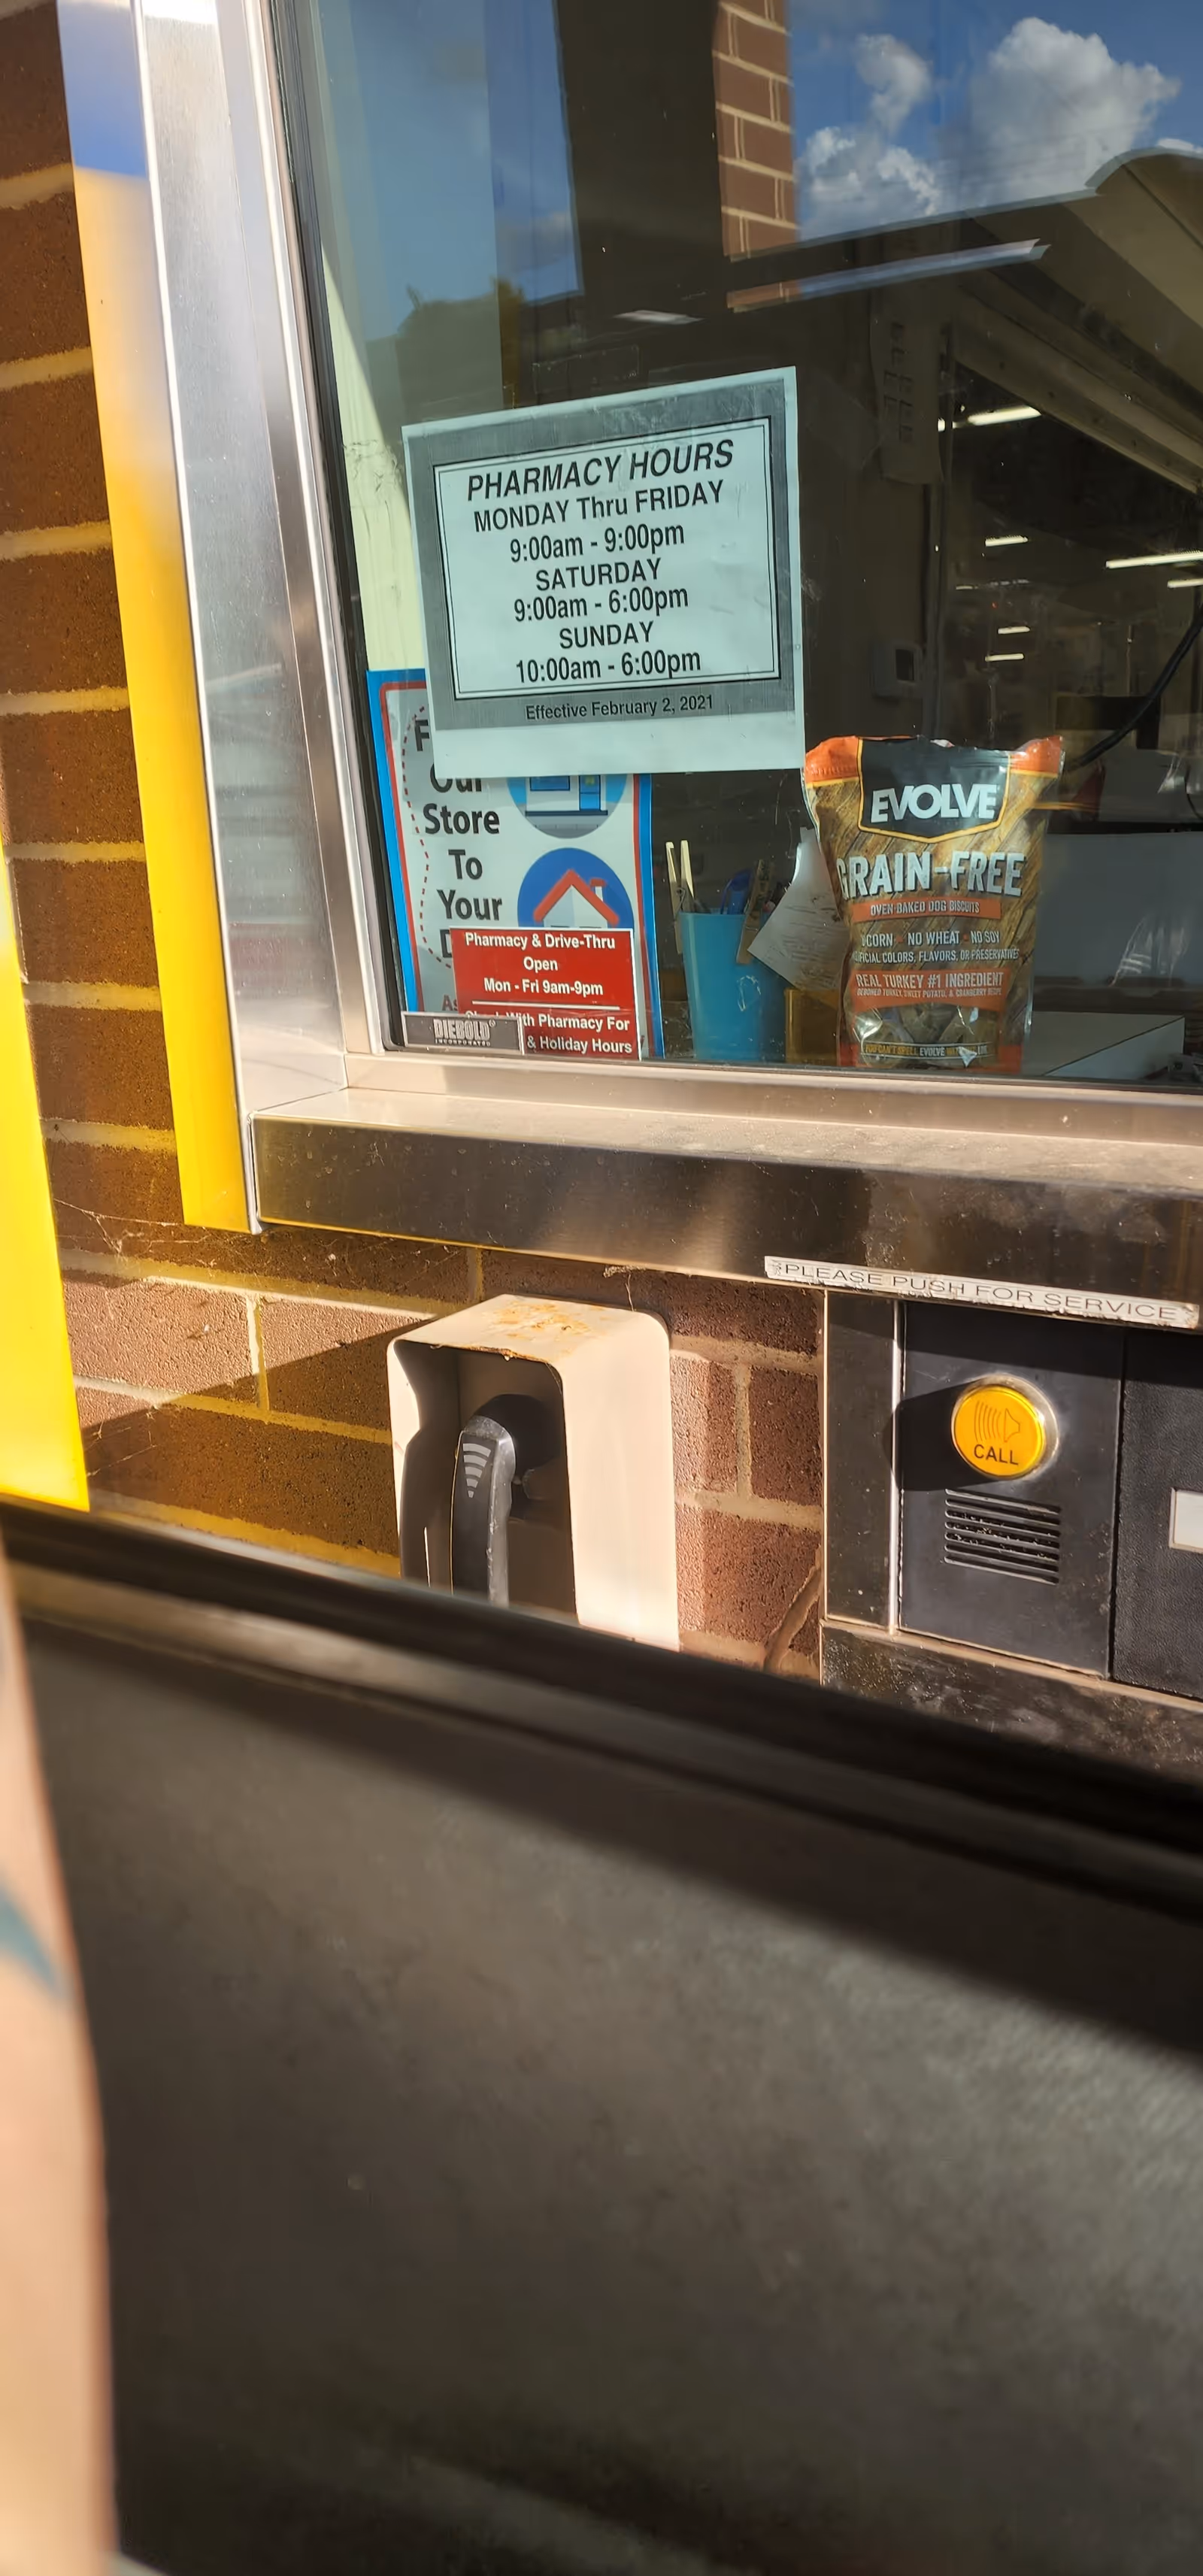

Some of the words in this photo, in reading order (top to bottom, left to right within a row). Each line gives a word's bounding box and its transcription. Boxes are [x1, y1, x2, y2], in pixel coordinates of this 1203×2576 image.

[467, 455, 622, 502] PHARMACY
[629, 439, 735, 480] HOURS
[473, 499, 569, 532] MONDAY
[577, 496, 628, 519] Thru
[635, 479, 724, 514] FRIDAY
[510, 535, 583, 562] 9:00am
[605, 523, 685, 554] 9:00pm
[535, 557, 661, 592] SATURDAY
[514, 597, 588, 622] 9:00am
[608, 586, 689, 617] 6:00pm
[559, 620, 653, 650] SUNDAY
[516, 656, 602, 683] 10:00am
[621, 650, 701, 679] 6:00pm
[526, 703, 588, 720] Effective
[592, 700, 657, 717] February
[662, 697, 675, 714] 2,
[680, 694, 713, 711] 2021
[871, 783, 997, 823] EVOLVE
[423, 803, 500, 835] Store
[448, 849, 483, 880] To
[836, 850, 1025, 900] GRAIN-FREE
[436, 889, 503, 921] Your
[929, 900, 947, 913] DOG
[950, 900, 980, 914] BISCUITS
[465, 932, 528, 951] Pharmacy
[532, 933, 542, 948] &
[545, 933, 616, 949] Drive-Thru
[908, 932, 923, 946] NO
[926, 931, 959, 945] WHEAT
[971, 931, 983, 944] NO
[984, 931, 1000, 944] SOY
[523, 956, 558, 973] Open
[882, 951, 916, 964] COLORS,
[919, 950, 958, 962] FLAVORS,
[960, 950, 970, 961] OR
[971, 948, 1020, 961] PRESERVATIVES
[484, 977, 511, 993] Mon
[522, 978, 539, 993] Fri
[542, 980, 603, 998] 9am-9pm
[856, 974, 882, 988] REAL
[883, 974, 924, 989] TURKEY
[927, 974, 941, 988] #1
[945, 972, 1004, 988] INGREDIENT
[538, 1014, 603, 1032] Pharmacy
[608, 1017, 630, 1031] For
[527, 1035, 536, 1049] &
[540, 1036, 588, 1054] Holiday
[592, 1038, 632, 1053] Hours
[920, 1046, 945, 1057] EVOLVE
[786, 1264, 883, 1286] PLEASE
[892, 1276, 965, 1295] PUSH
[977, 1285, 1033, 1303] FOR
[1044, 1294, 1176, 1320] SERVICE
[974, 1444, 1019, 1465] CALL
